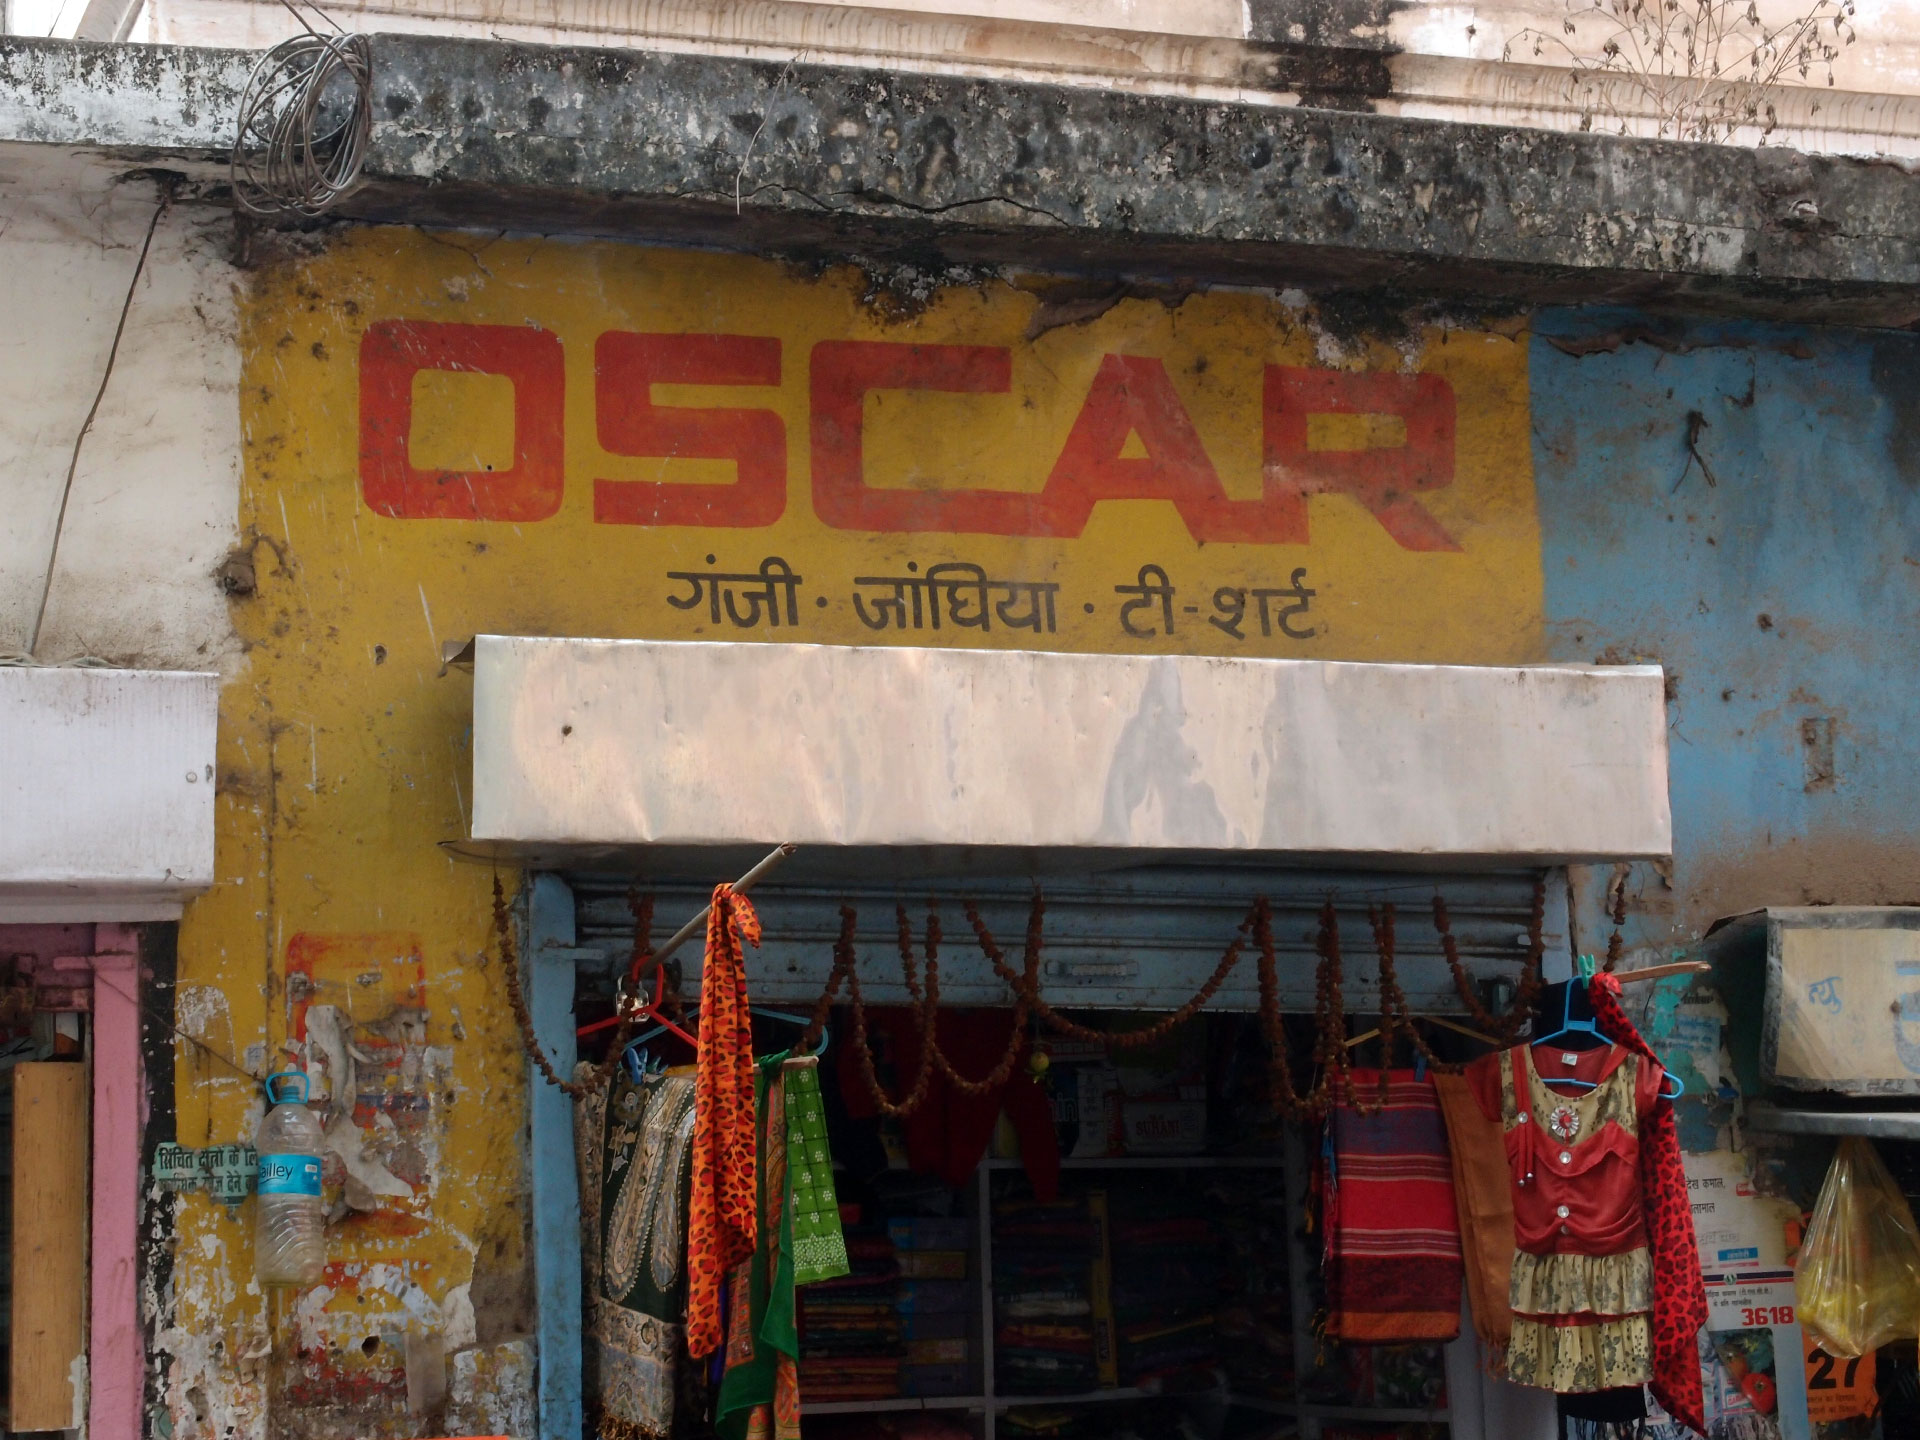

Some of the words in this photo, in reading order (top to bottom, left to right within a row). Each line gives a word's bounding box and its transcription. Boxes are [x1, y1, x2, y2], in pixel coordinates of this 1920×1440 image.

[359, 319, 1465, 552] OSCAR
[667, 554, 802, 628] गंजी
[853, 561, 1060, 635] जांघिया
[1115, 563, 1315, 640] टी-शर्ट
[158, 1146, 193, 1169] सिंचित
[258, 1162, 294, 1181] ailley
[1690, 1202, 1715, 1214] ालामाल
[1741, 1306, 1794, 1326] 3618
[1808, 1348, 1861, 1389] 27
